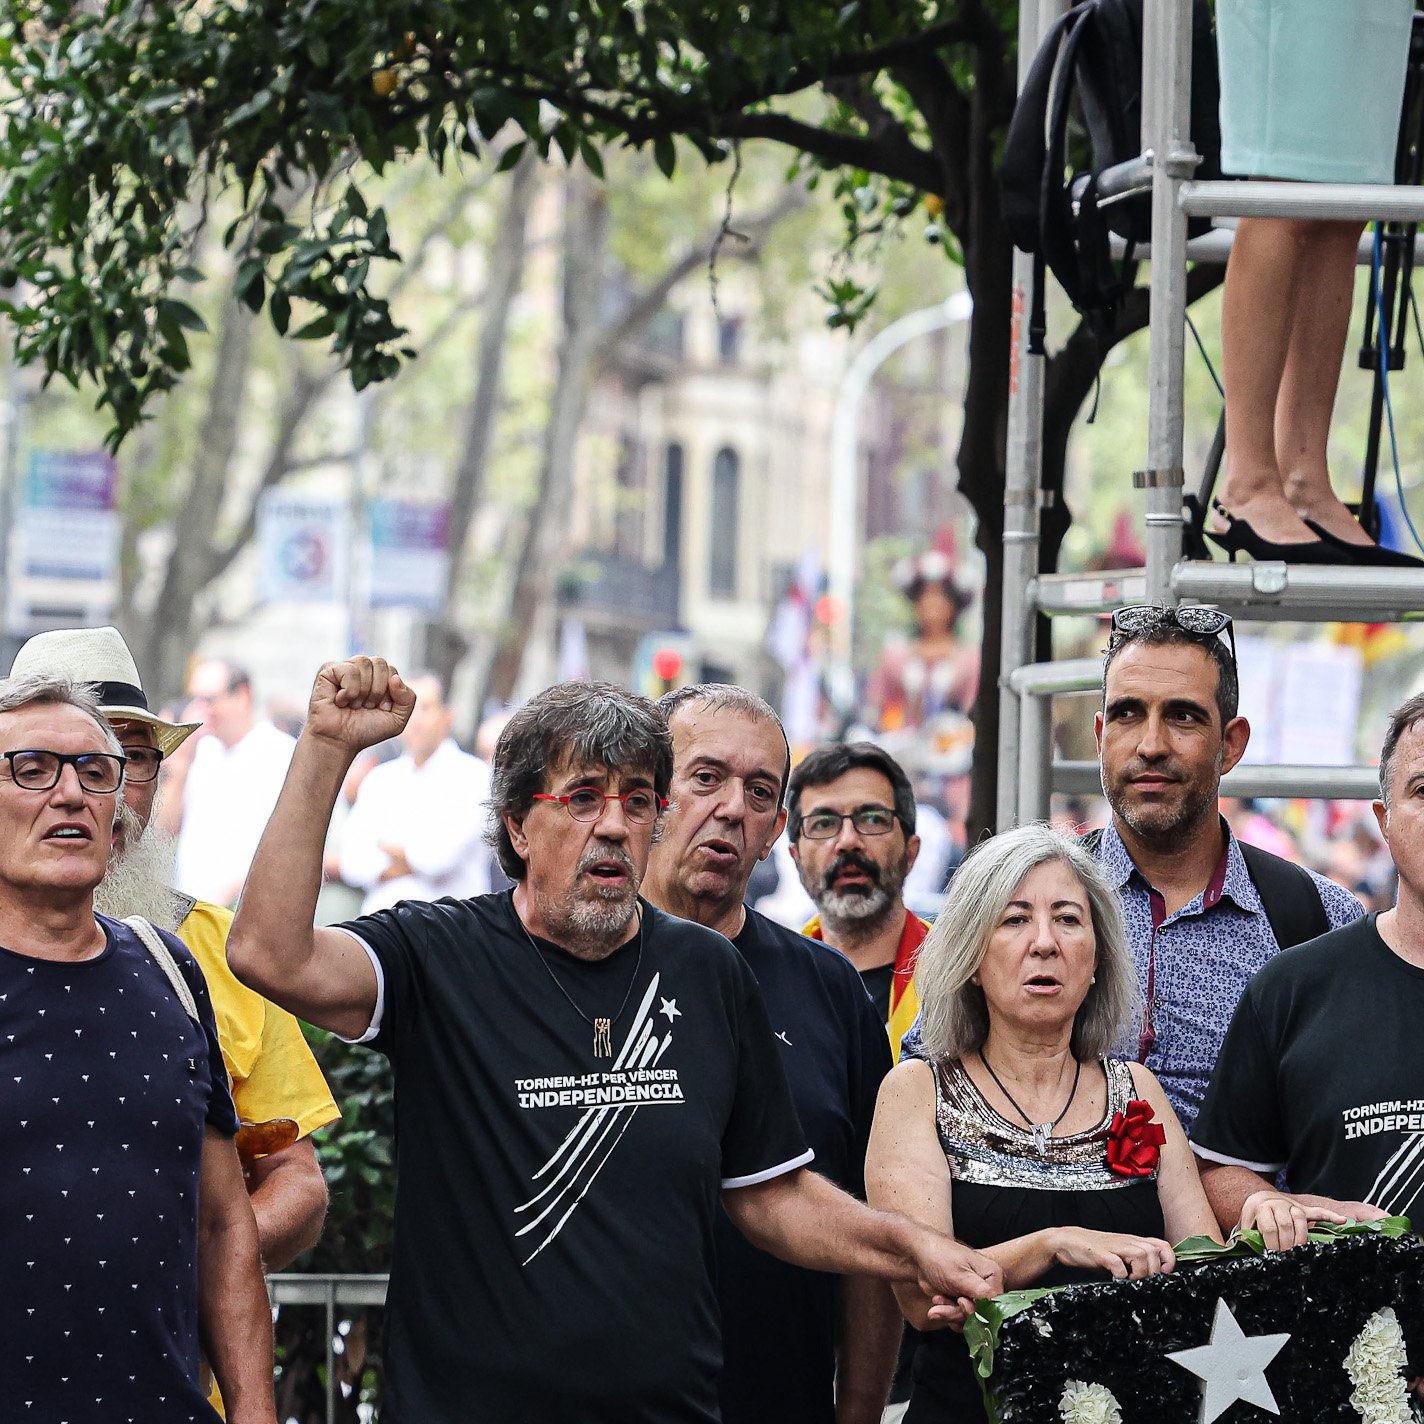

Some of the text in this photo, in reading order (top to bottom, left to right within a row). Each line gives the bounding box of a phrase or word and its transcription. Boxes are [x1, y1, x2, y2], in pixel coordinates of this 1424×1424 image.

[514, 1067, 678, 1091] TORNEM-HI PER VÈNCER
[517, 1081, 685, 1109] INDEPENDÈNCIA
[1342, 1100, 1424, 1121] TORNEM-HI
